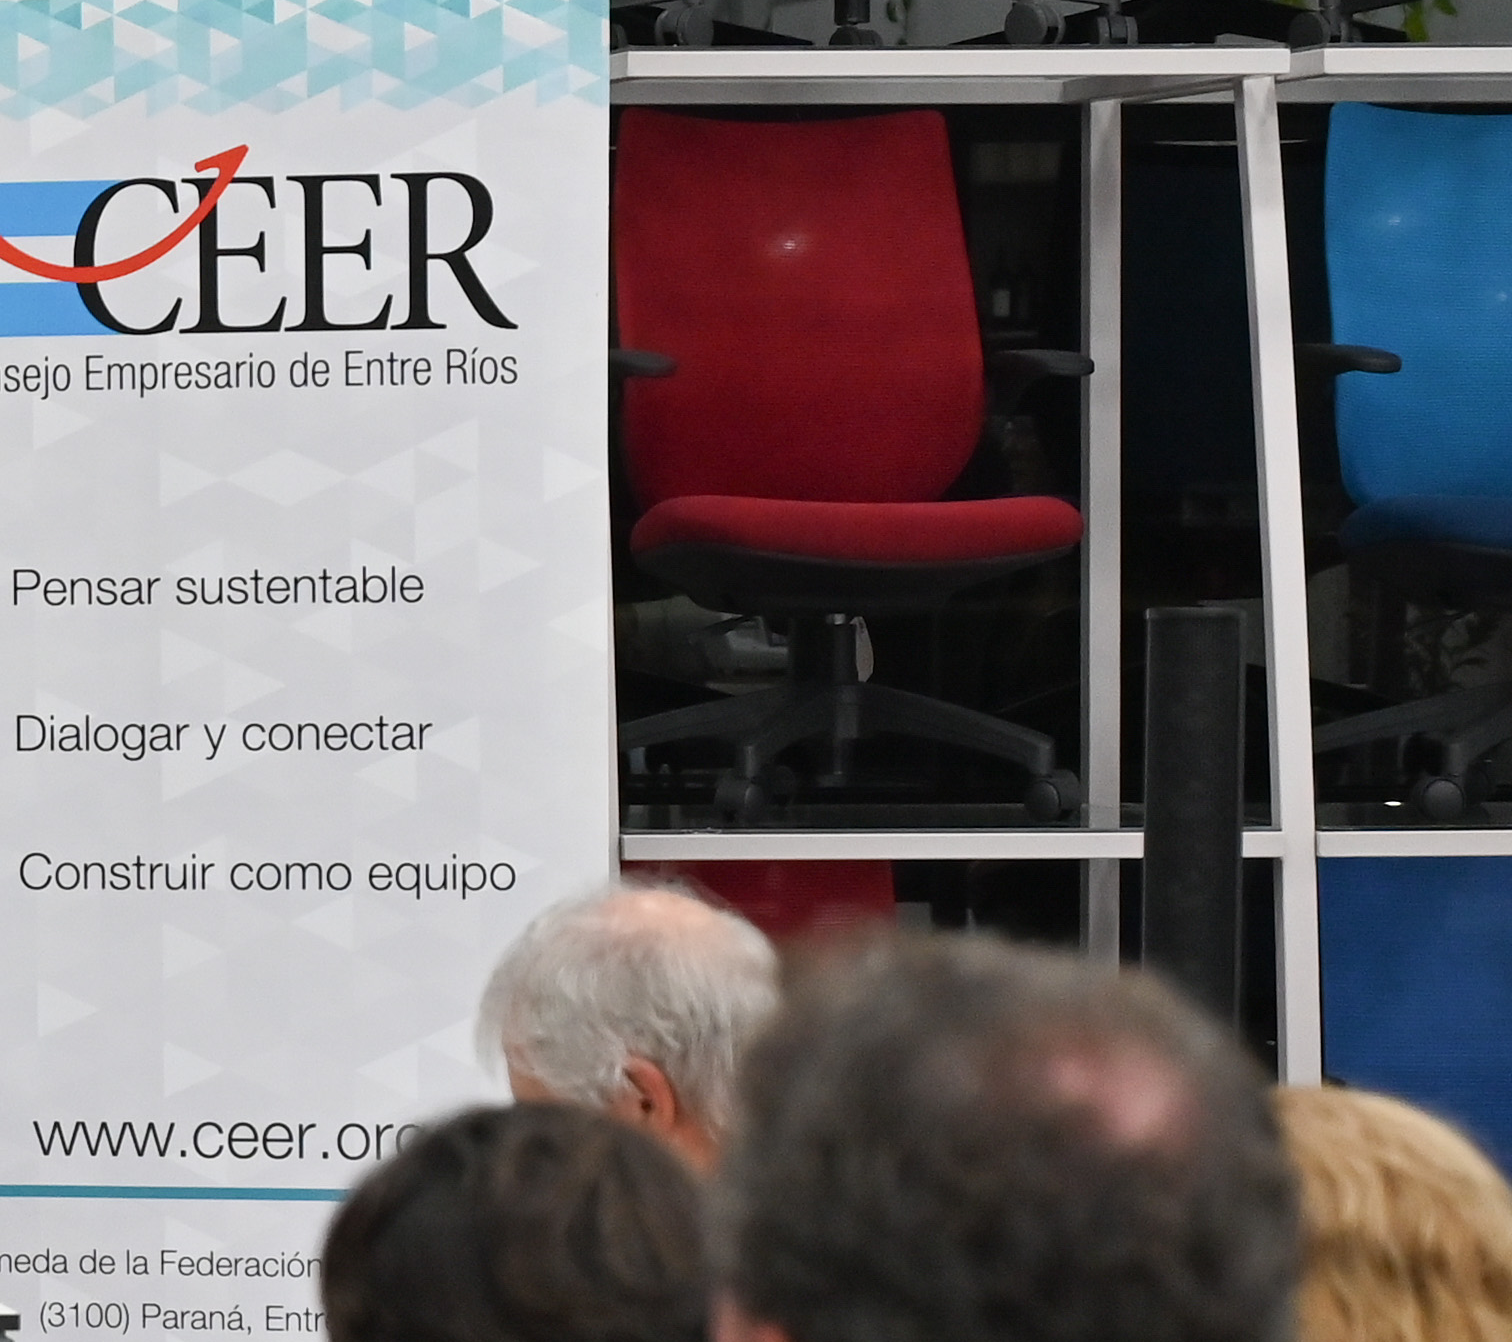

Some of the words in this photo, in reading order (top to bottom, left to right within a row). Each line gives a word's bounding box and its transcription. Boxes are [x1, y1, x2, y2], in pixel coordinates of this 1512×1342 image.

[73, 172, 519, 336] CEER
[85, 352, 276, 398] Empresario
[289, 351, 330, 389] de
[345, 349, 432, 387] Entre
[446, 346, 518, 386] Ríos
[13, 568, 161, 607] Pensar
[175, 565, 425, 606] sustentable
[16, 714, 190, 762] Dialogar
[203, 724, 227, 762] y
[241, 715, 434, 753] conectar
[19, 852, 215, 892] Construir
[229, 861, 353, 892] como
[367, 852, 517, 901] equipo
[79, 1249, 116, 1275] de
[125, 1249, 150, 1276] la
[160, 1249, 323, 1278] Federación
[39, 1301, 131, 1335] (3100)
[141, 1303, 253, 1335] Paraná,
[265, 1305, 326, 1332] Entr
